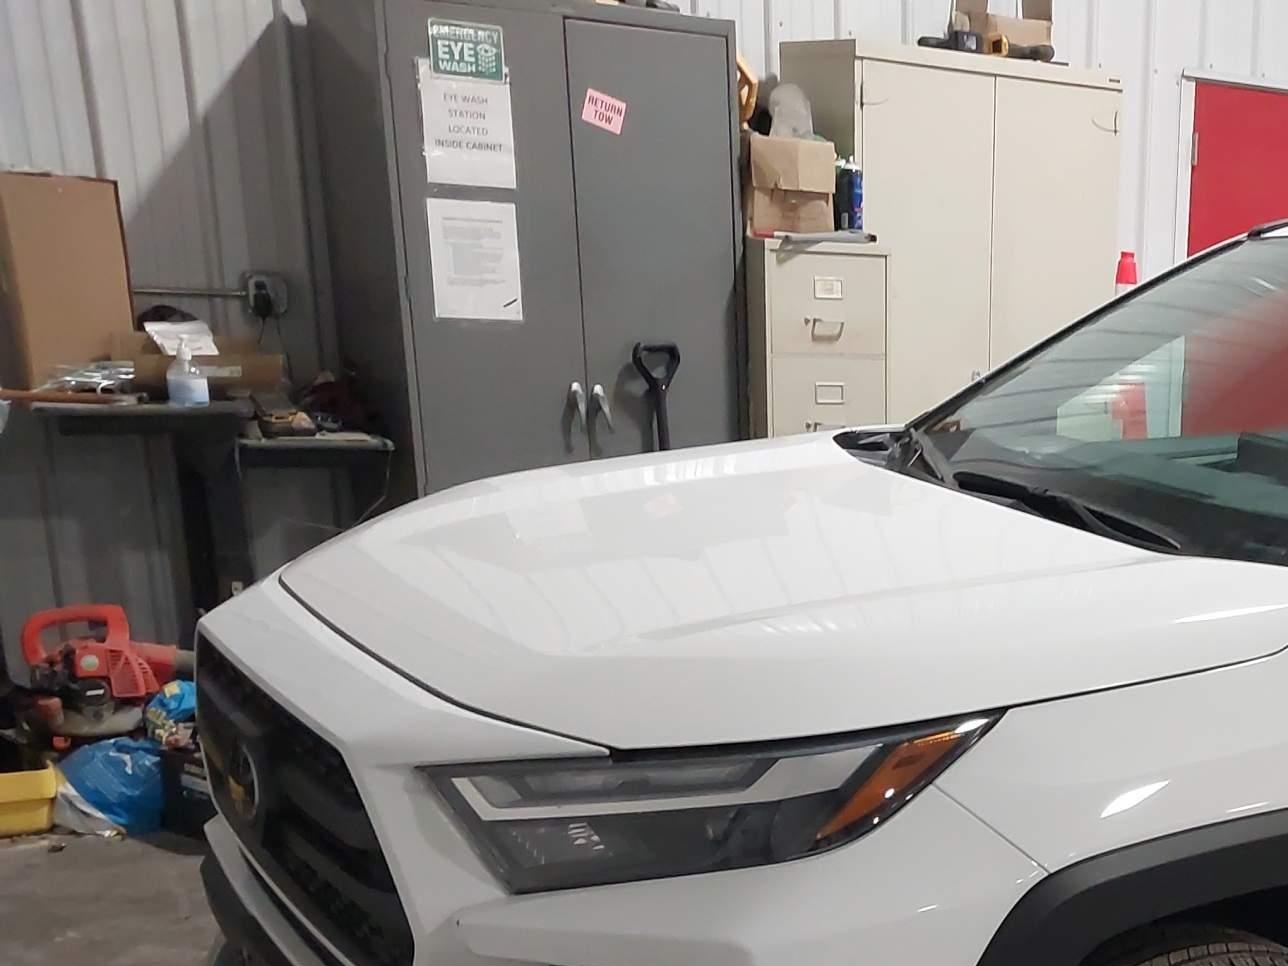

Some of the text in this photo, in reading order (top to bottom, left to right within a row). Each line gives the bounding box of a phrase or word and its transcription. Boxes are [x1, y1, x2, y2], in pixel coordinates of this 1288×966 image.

[432, 24, 499, 43] EMERGENCY
[437, 39, 476, 63] EYE
[438, 60, 476, 73] WASH
[443, 92, 488, 104] EYE WASH
[448, 108, 486, 120] STATION
[587, 95, 623, 118] RETURN
[593, 109, 614, 126] TOW
[448, 124, 489, 137] LOCATED
[434, 138, 503, 153] INSIDE CABINET
